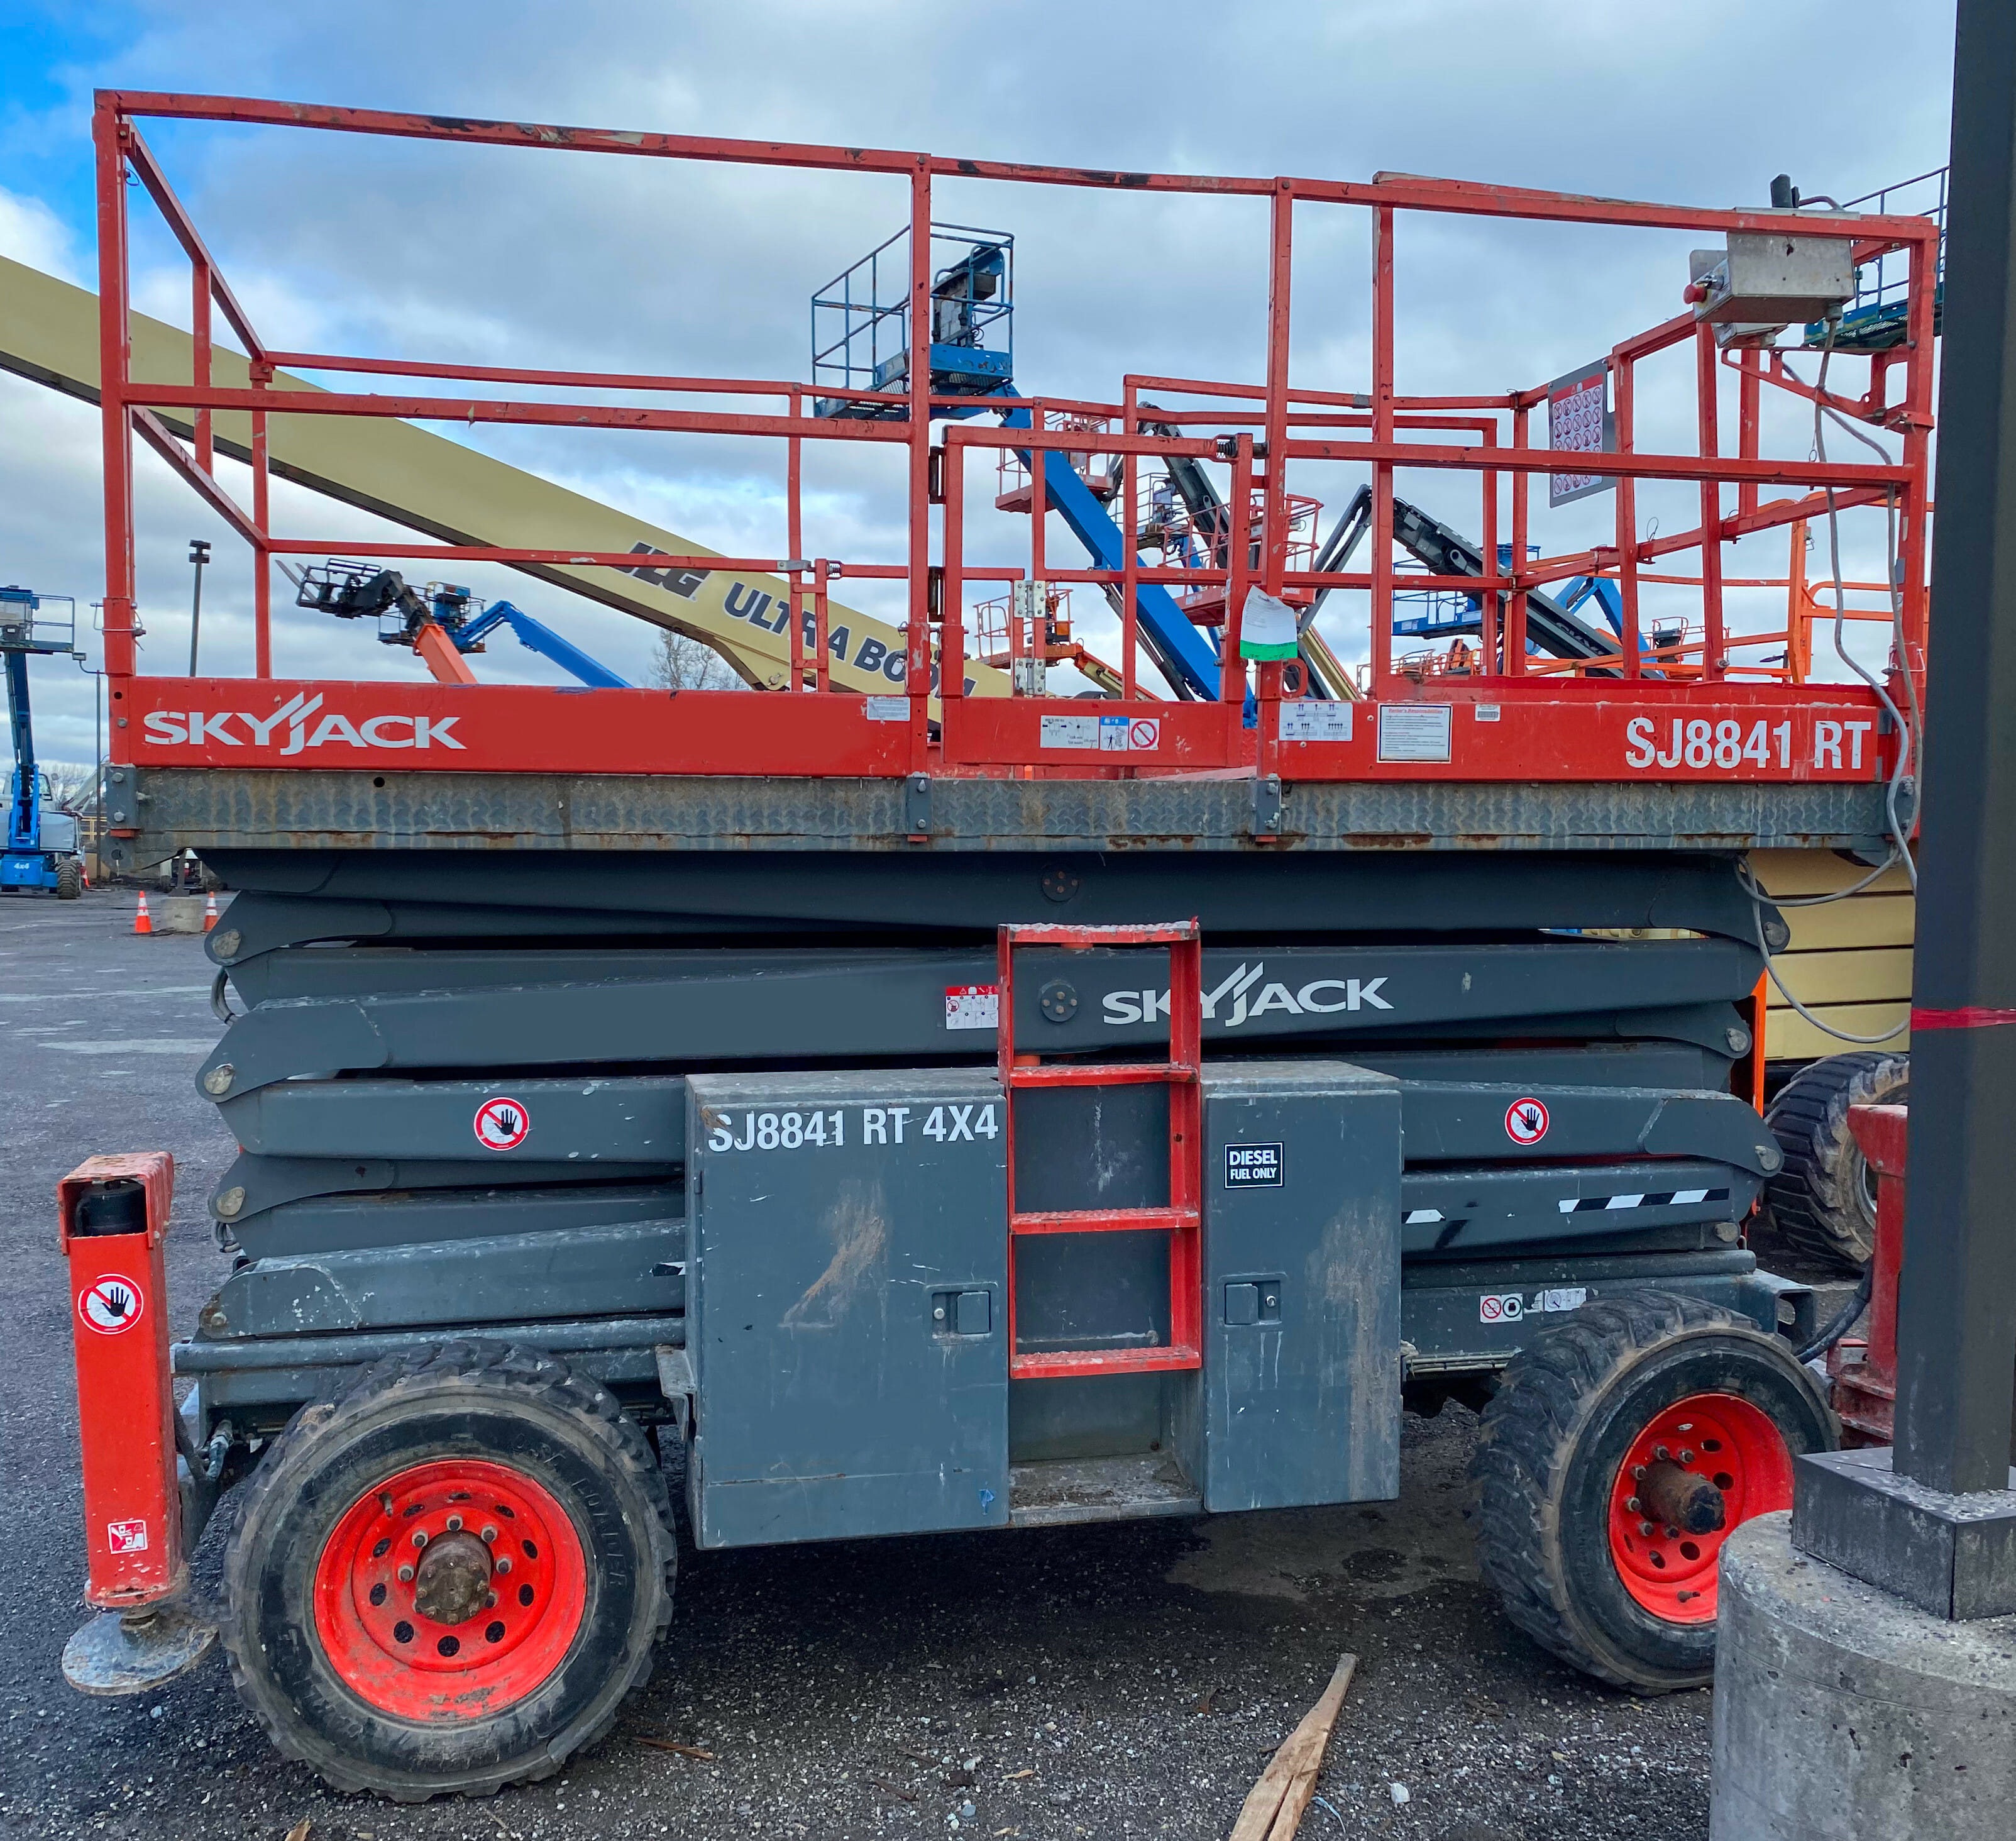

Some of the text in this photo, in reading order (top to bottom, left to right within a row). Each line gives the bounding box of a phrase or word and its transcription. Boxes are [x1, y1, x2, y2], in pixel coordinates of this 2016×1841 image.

[724, 582, 850, 661] ULTRA
[143, 692, 468, 755] SKYJACK
[1625, 717, 1871, 770] SJ8841 RT
[1101, 961, 1395, 1027] SKYJACK
[708, 1103, 999, 1152] SJ8841 RT 4X4
[1229, 1149, 1278, 1166] DIESEL
[1230, 1167, 1277, 1180] FUEL ONLY
